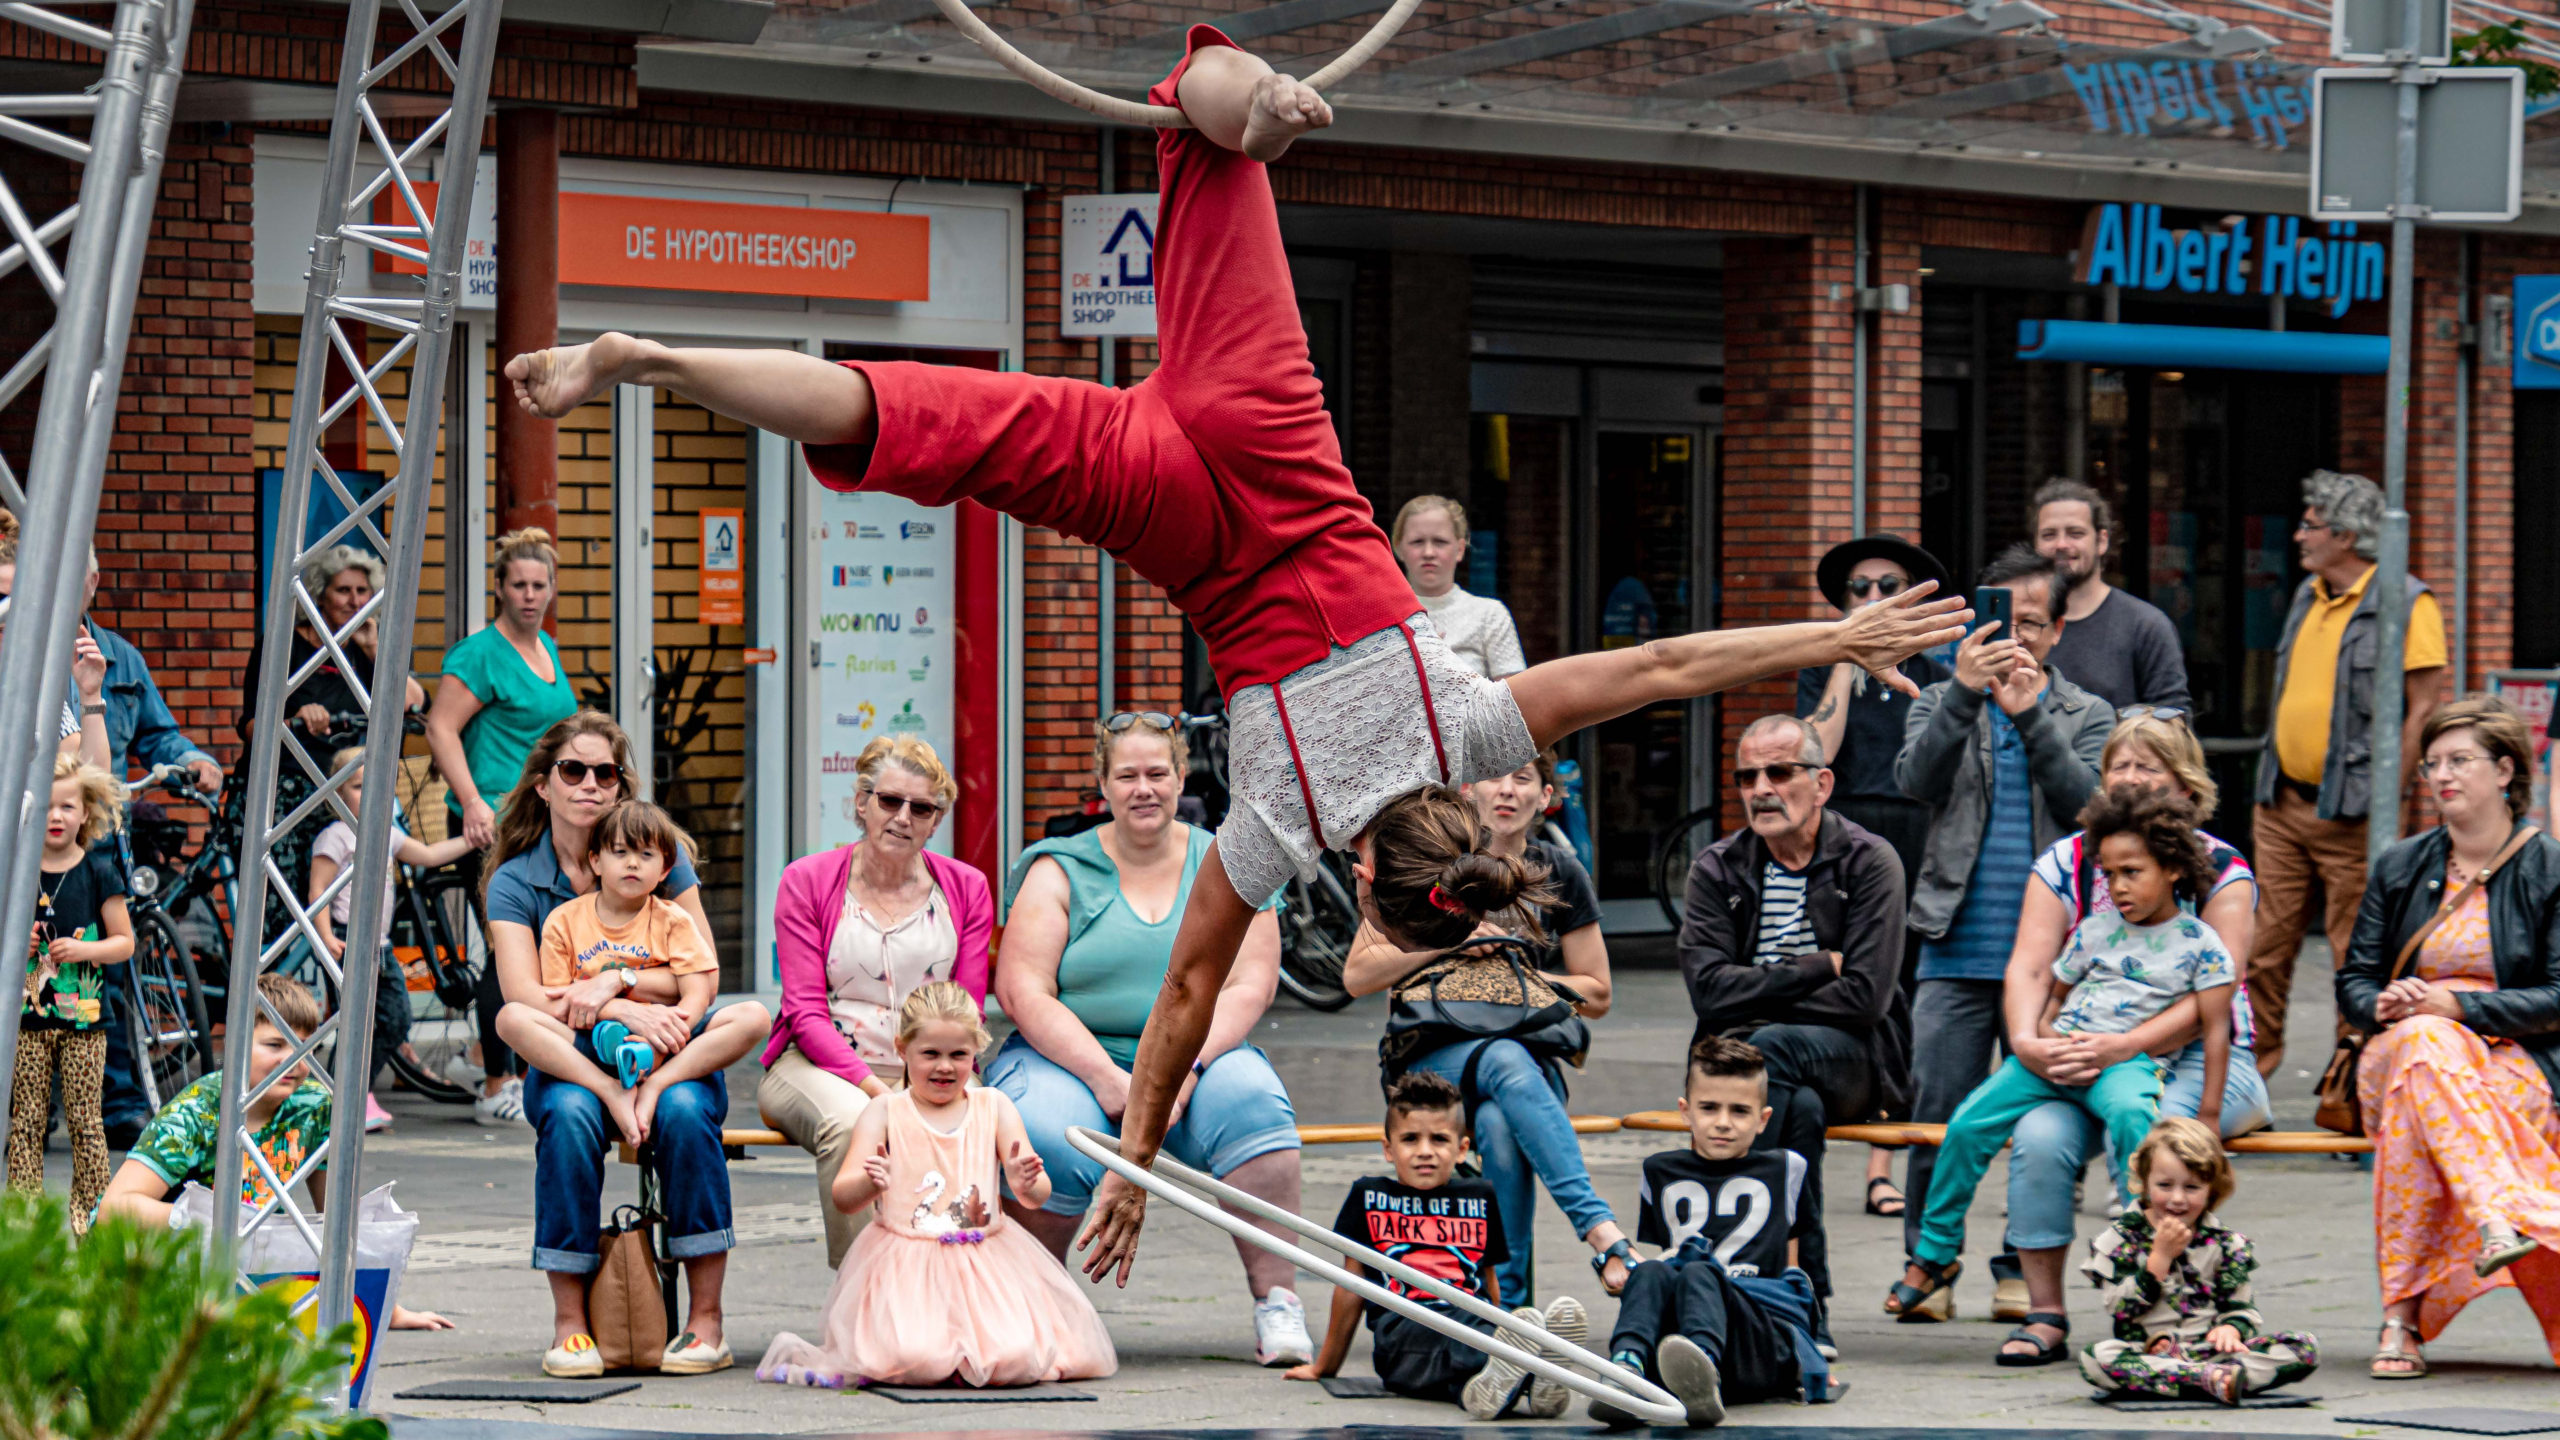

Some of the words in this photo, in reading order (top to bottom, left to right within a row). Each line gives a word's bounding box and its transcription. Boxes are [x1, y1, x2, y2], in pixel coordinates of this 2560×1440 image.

[468, 240, 485, 256] DE
[626, 225, 656, 259] DE
[665, 228, 856, 270] HYPOTHEEKSHOP
[469, 260, 496, 275] HYP
[2085, 202, 2252, 295] Albert
[2261, 214, 2384, 319] Heijn
[469, 279, 497, 295] SHO
[1072, 273, 1092, 287] DE
[1072, 290, 1155, 305] HYPOTHEE
[1072, 309, 1116, 323] SHOP
[820, 612, 901, 632] woonnu
[845, 653, 896, 680] florius
[576, 940, 610, 970] LAGUNA
[1364, 1190, 1423, 1216] POWER
[1428, 1196, 1451, 1216] OF
[1457, 1198, 1488, 1218] THE
[1370, 1214, 1426, 1242] DARK
[1436, 1220, 1484, 1247] SIDE
[1660, 1176, 1772, 1278] 82
